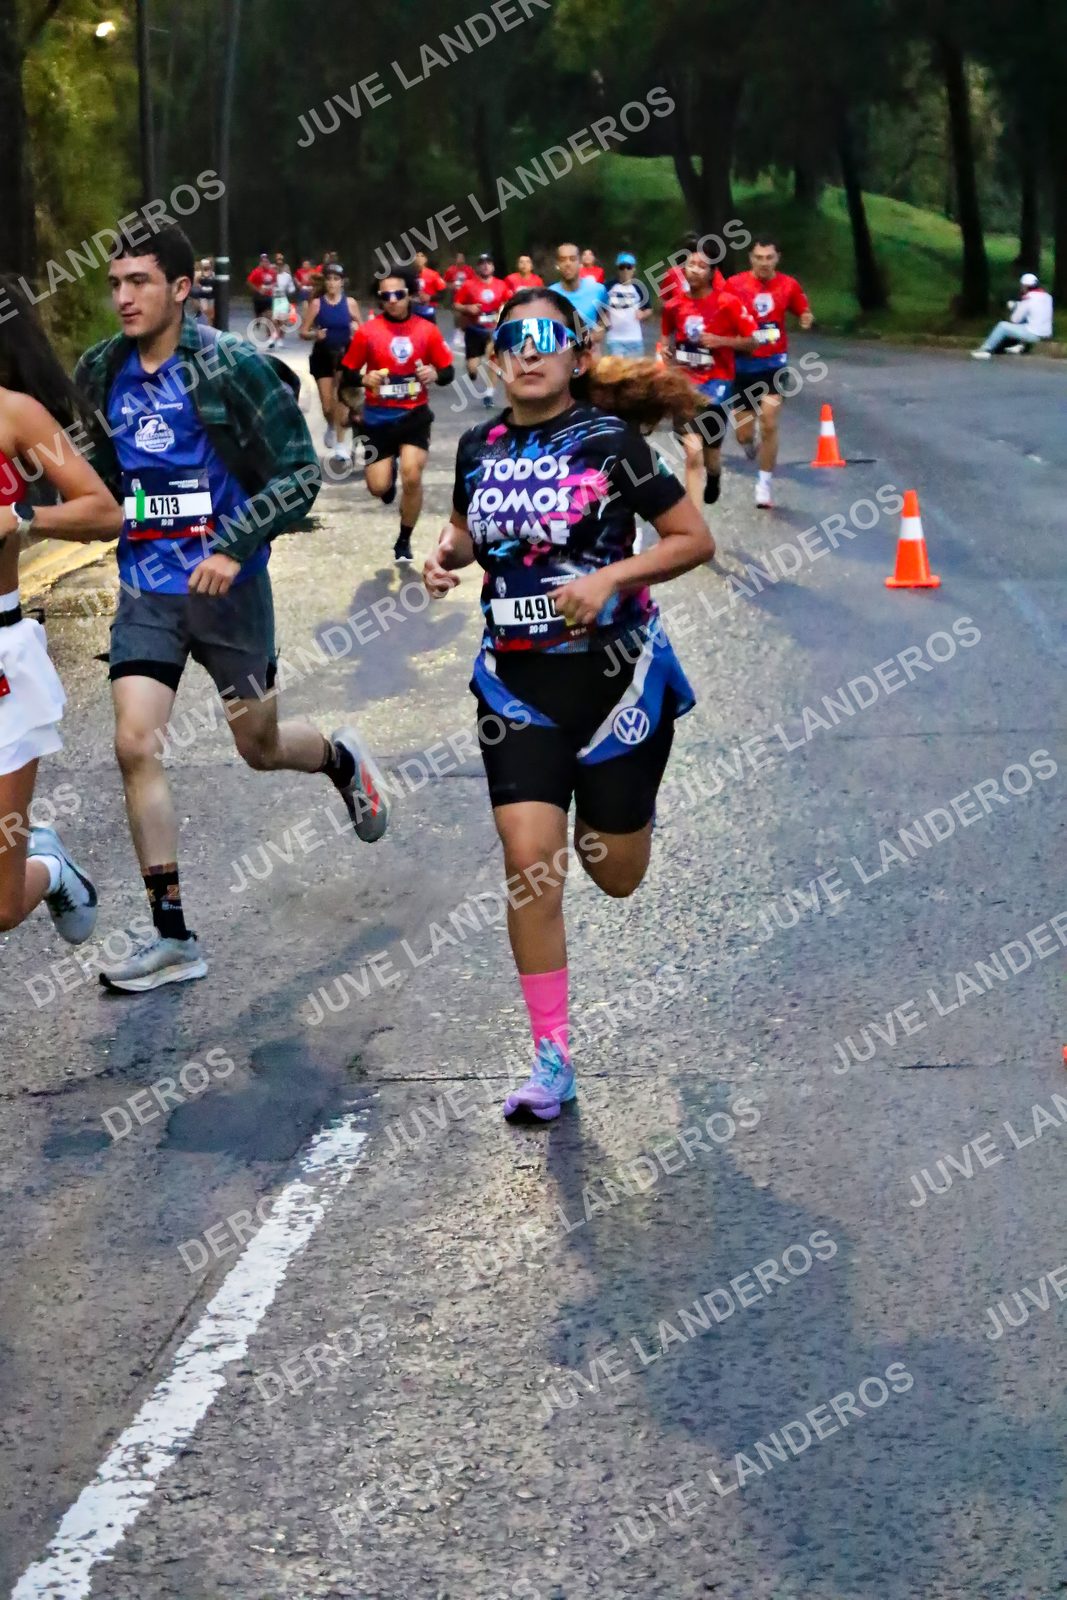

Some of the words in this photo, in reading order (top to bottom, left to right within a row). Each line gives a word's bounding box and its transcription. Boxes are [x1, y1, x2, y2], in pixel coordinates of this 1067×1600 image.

[481, 455, 573, 481] TODOS
[150, 497, 180, 515] 4713
[472, 487, 572, 512] SOMOS
[614, 707, 650, 744] VW
